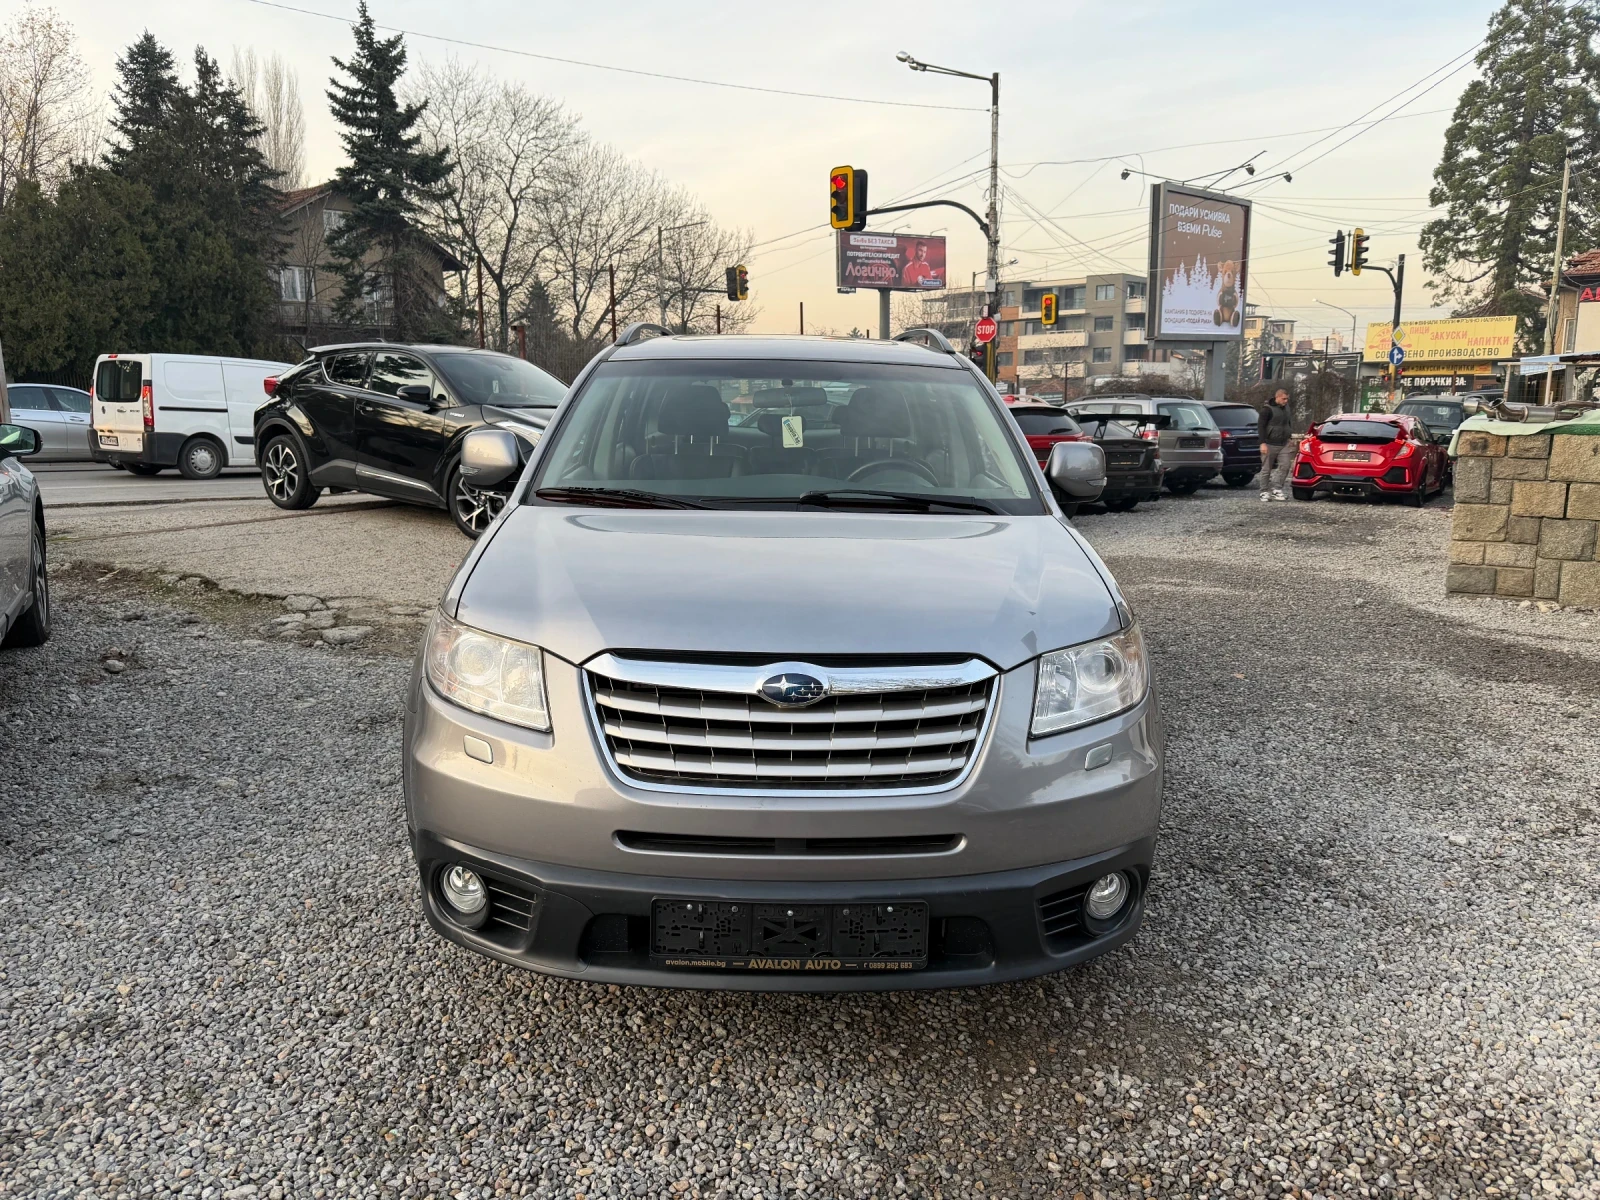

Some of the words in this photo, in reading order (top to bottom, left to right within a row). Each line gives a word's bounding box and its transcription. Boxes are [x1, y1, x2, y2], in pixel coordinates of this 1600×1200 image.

[1169, 203, 1198, 218] ПОДАРИ
[1199, 208, 1231, 223] УСМИВКА
[1177, 221, 1201, 235] ВЗЕМИ
[1201, 224, 1223, 238] Pulse
[977, 325, 994, 334] STOP
[1409, 326, 1430, 335] ПИЦИ
[1430, 330, 1468, 341] ЗАКУСКИ
[1467, 336, 1509, 346] НАПИТКИ
[1427, 347, 1499, 358] ПРОИЗВОДСТВО
[1414, 376, 1452, 386] ПОРЪЧКИ
[665, 958, 727, 968] avalon.mobile.bg
[748, 959, 800, 970] AVALON
[804, 959, 842, 970] AUTO
